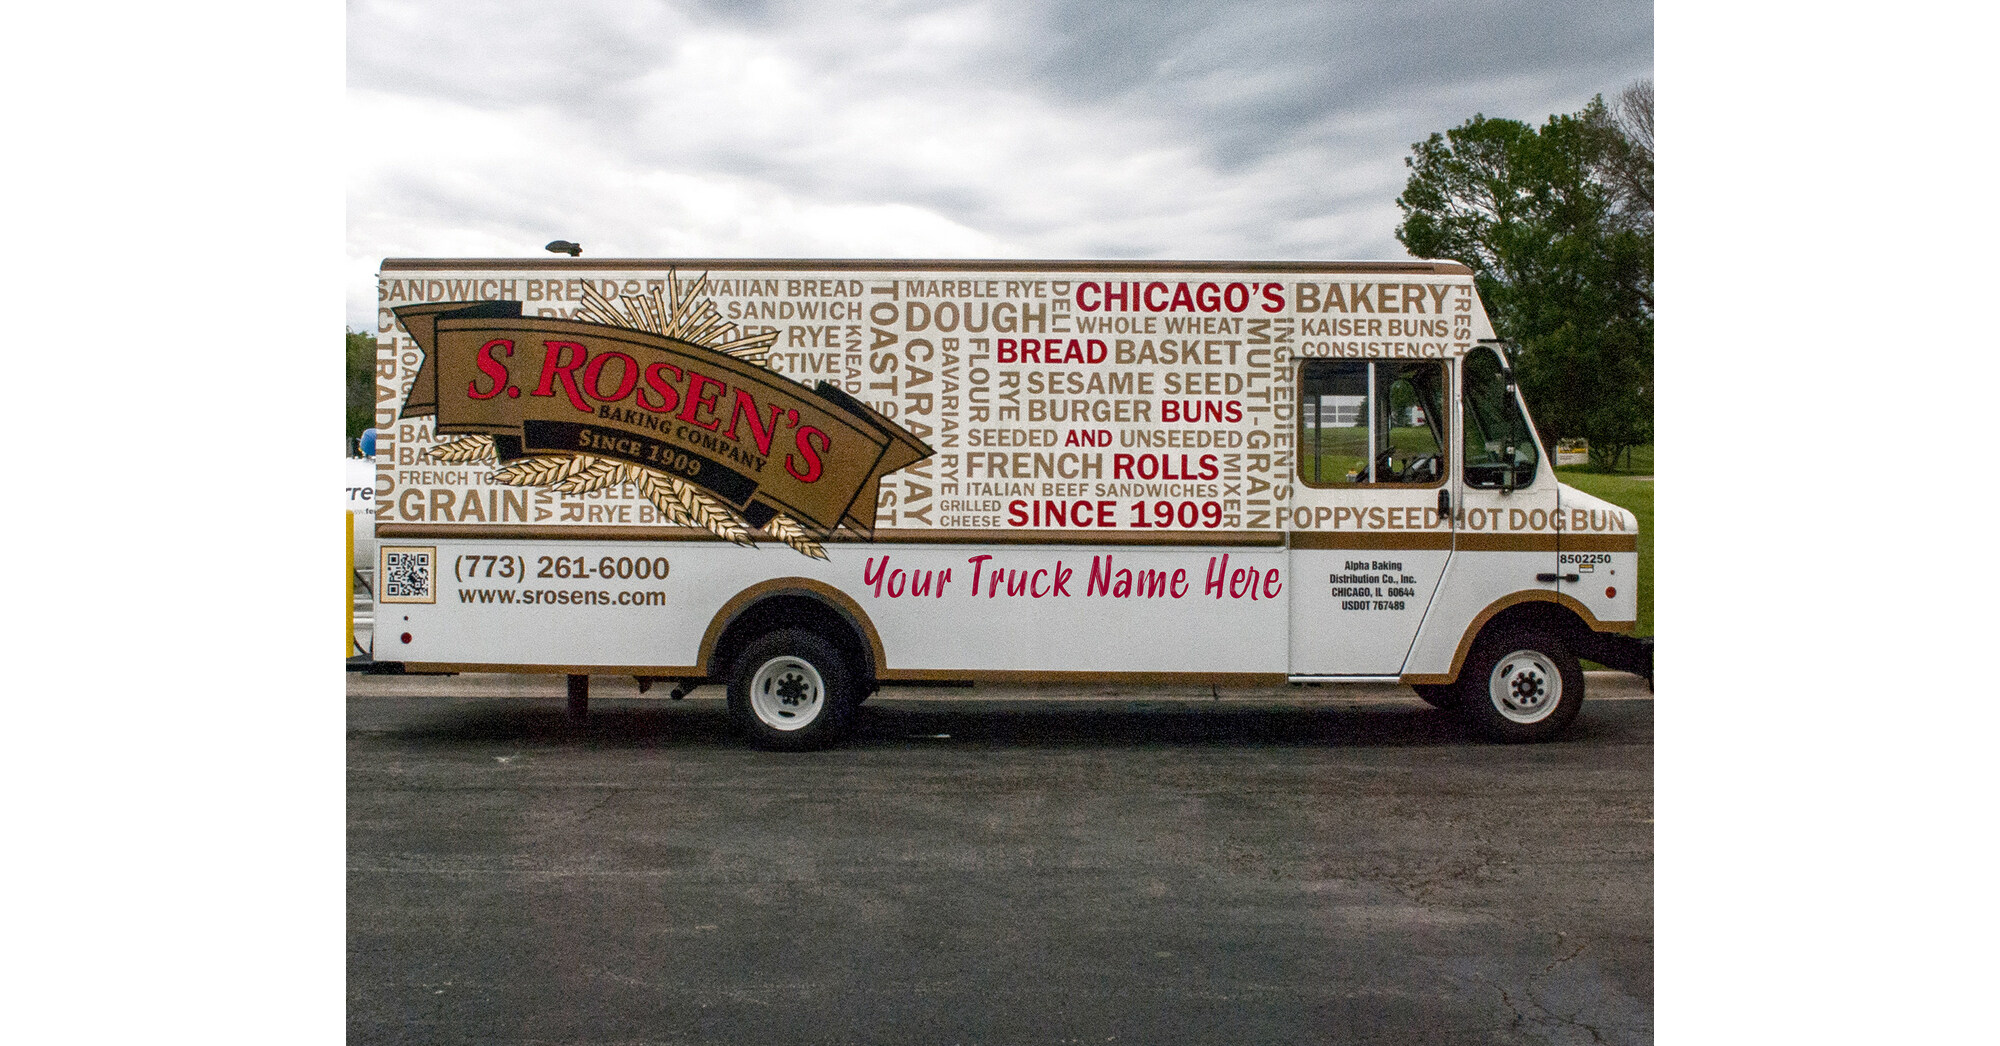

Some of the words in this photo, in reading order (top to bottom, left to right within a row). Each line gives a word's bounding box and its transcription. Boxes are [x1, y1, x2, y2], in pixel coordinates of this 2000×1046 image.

[378, 280, 516, 301] SANDWICH
[787, 281, 864, 298] BREAD
[906, 281, 998, 298] MARBLE
[1006, 281, 1047, 298] RYE
[1076, 281, 1286, 313] CHICAGO'S
[1296, 283, 1450, 314] BAKERY
[727, 302, 862, 320] SANDWICH
[906, 302, 1047, 333] DOUGH
[1052, 281, 1071, 333] DELI
[1453, 284, 1472, 356] FRESH
[788, 326, 841, 348] RYE
[869, 281, 900, 396] TOAST
[1076, 316, 1157, 334] WHOLE
[1164, 317, 1244, 335] WHEAT
[1301, 318, 1382, 337] KAISER
[1388, 319, 1449, 337] BUNS
[845, 325, 862, 395] KNEAD
[998, 339, 1108, 364] BREAD
[1115, 340, 1242, 365] BASKET
[1301, 341, 1448, 358] CONSISTENCY
[941, 338, 959, 447] BAVARIAN
[969, 338, 990, 423] FLOUR
[1027, 371, 1154, 395] SESAME
[1164, 372, 1244, 395] SEED
[999, 371, 1020, 421] RYE
[1273, 317, 1295, 501] INGREDIENTS
[467, 339, 521, 399] S.
[531, 340, 831, 483] ROSEN'S
[1028, 399, 1151, 422] BURGER
[1161, 400, 1243, 423] BUNS
[1247, 318, 1271, 529] MULTI-GRAIN
[375, 337, 397, 521] TRADITION
[599, 405, 672, 434] BAKING
[676, 426, 767, 472] COMPANY
[967, 428, 1058, 447] SEEDED
[1064, 429, 1113, 448] AND
[1120, 430, 1243, 448] UNSEEDED
[649, 444, 701, 476] 1909
[966, 452, 1102, 479] FRENCH
[1114, 453, 1219, 480] ROLLS
[399, 471, 468, 485] FRENCH
[941, 454, 959, 496] RYE
[966, 482, 1035, 497] ITALIAN
[1042, 483, 1089, 497] BEEF
[1095, 483, 1218, 498] SANDWICHES
[1223, 453, 1241, 528] MIXER
[399, 488, 528, 523] GRAIN
[589, 504, 631, 522] RYE
[940, 500, 1000, 512] GRILLED
[1008, 500, 1117, 527] SINCE
[1130, 500, 1222, 528] 1909
[1275, 506, 1441, 529] POPPYSEED
[1509, 508, 1567, 531] DOG
[1571, 509, 1626, 531] BUN
[940, 515, 1000, 527] CHEESE
[455, 555, 526, 583] (773)
[537, 556, 670, 580] 261-6000
[1344, 561, 1370, 571] Alpha
[1372, 561, 1402, 571] Baking
[1560, 554, 1611, 564] 8502250
[863, 555, 952, 598] Your
[968, 554, 1072, 598] Truck
[1087, 554, 1190, 599] Name
[1205, 553, 1283, 600] Here
[1329, 574, 1380, 584] Distribution
[1382, 574, 1398, 585] Co.,
[1400, 574, 1417, 584] Inc.
[459, 587, 667, 606] www.srosens.com
[1332, 587, 1373, 598] CHICAGO,
[1375, 587, 1383, 597] IL
[1388, 587, 1415, 597] 60644
[1342, 601, 1371, 610] USDOT
[1373, 601, 1405, 610] 767489
